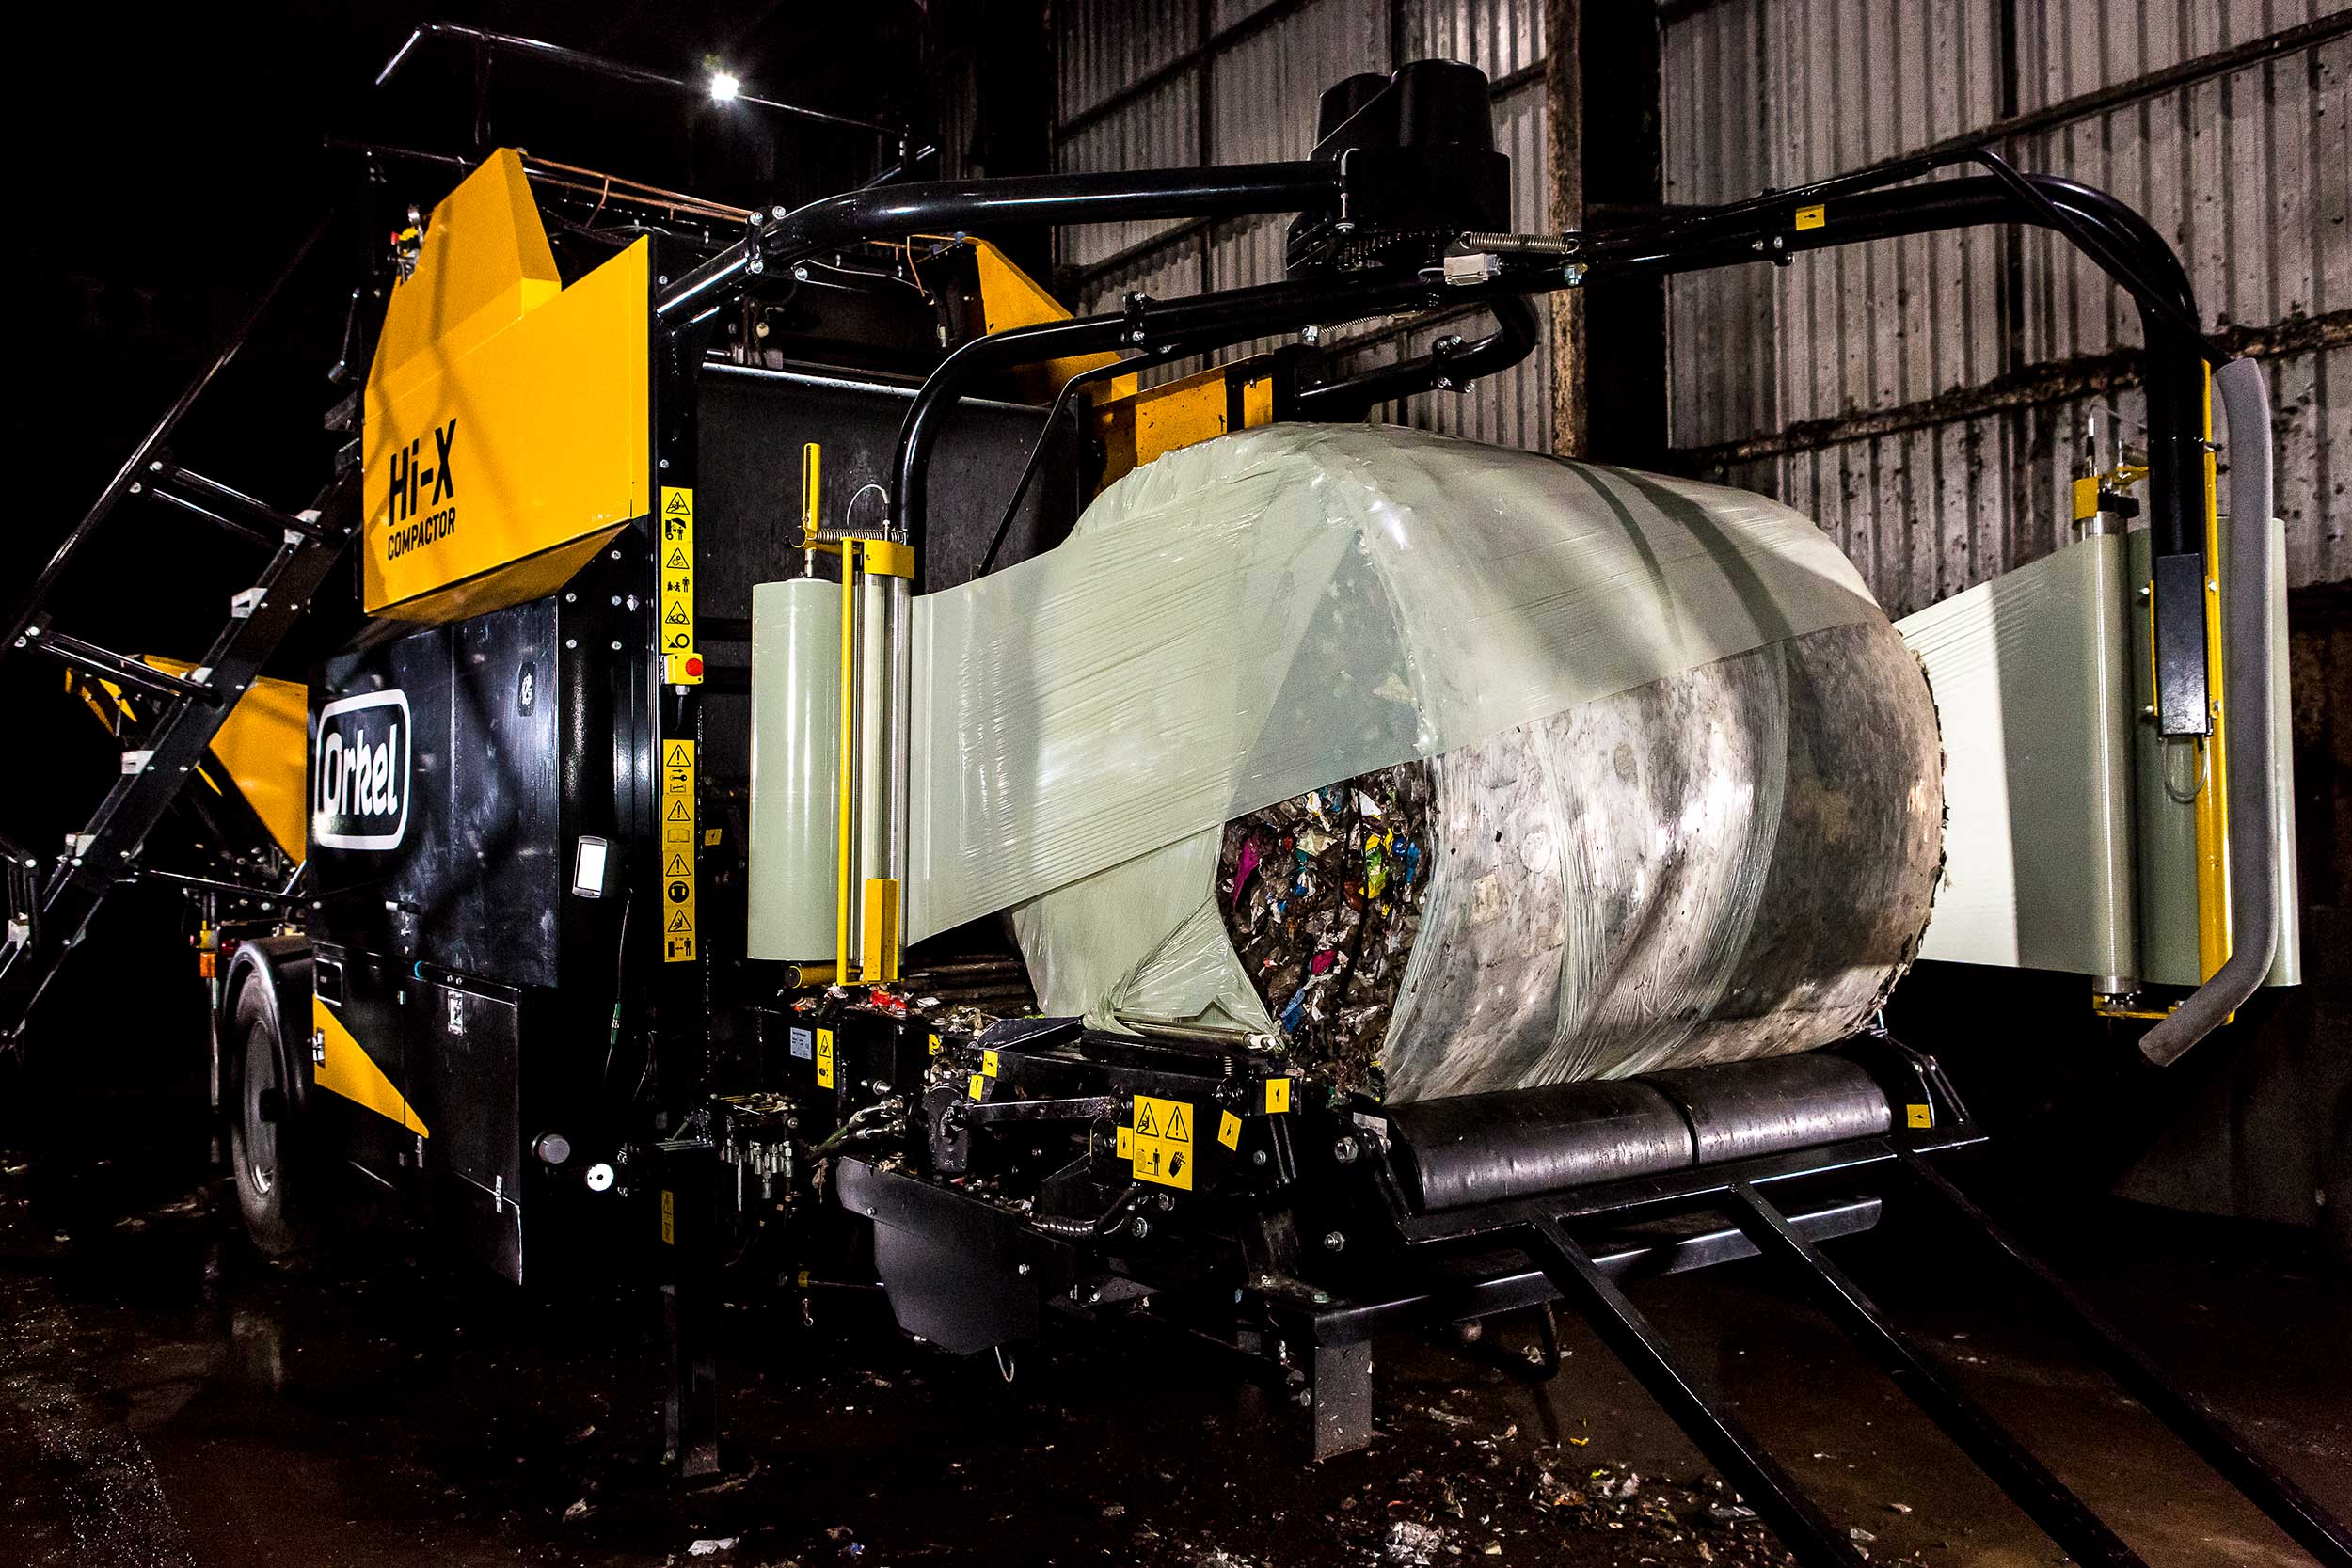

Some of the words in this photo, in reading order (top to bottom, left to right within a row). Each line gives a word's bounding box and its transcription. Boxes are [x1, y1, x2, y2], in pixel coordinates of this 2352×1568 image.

[389, 418, 457, 527] Hi-X
[388, 507, 456, 561] COMPACTOR
[324, 723, 398, 817] Orkel
